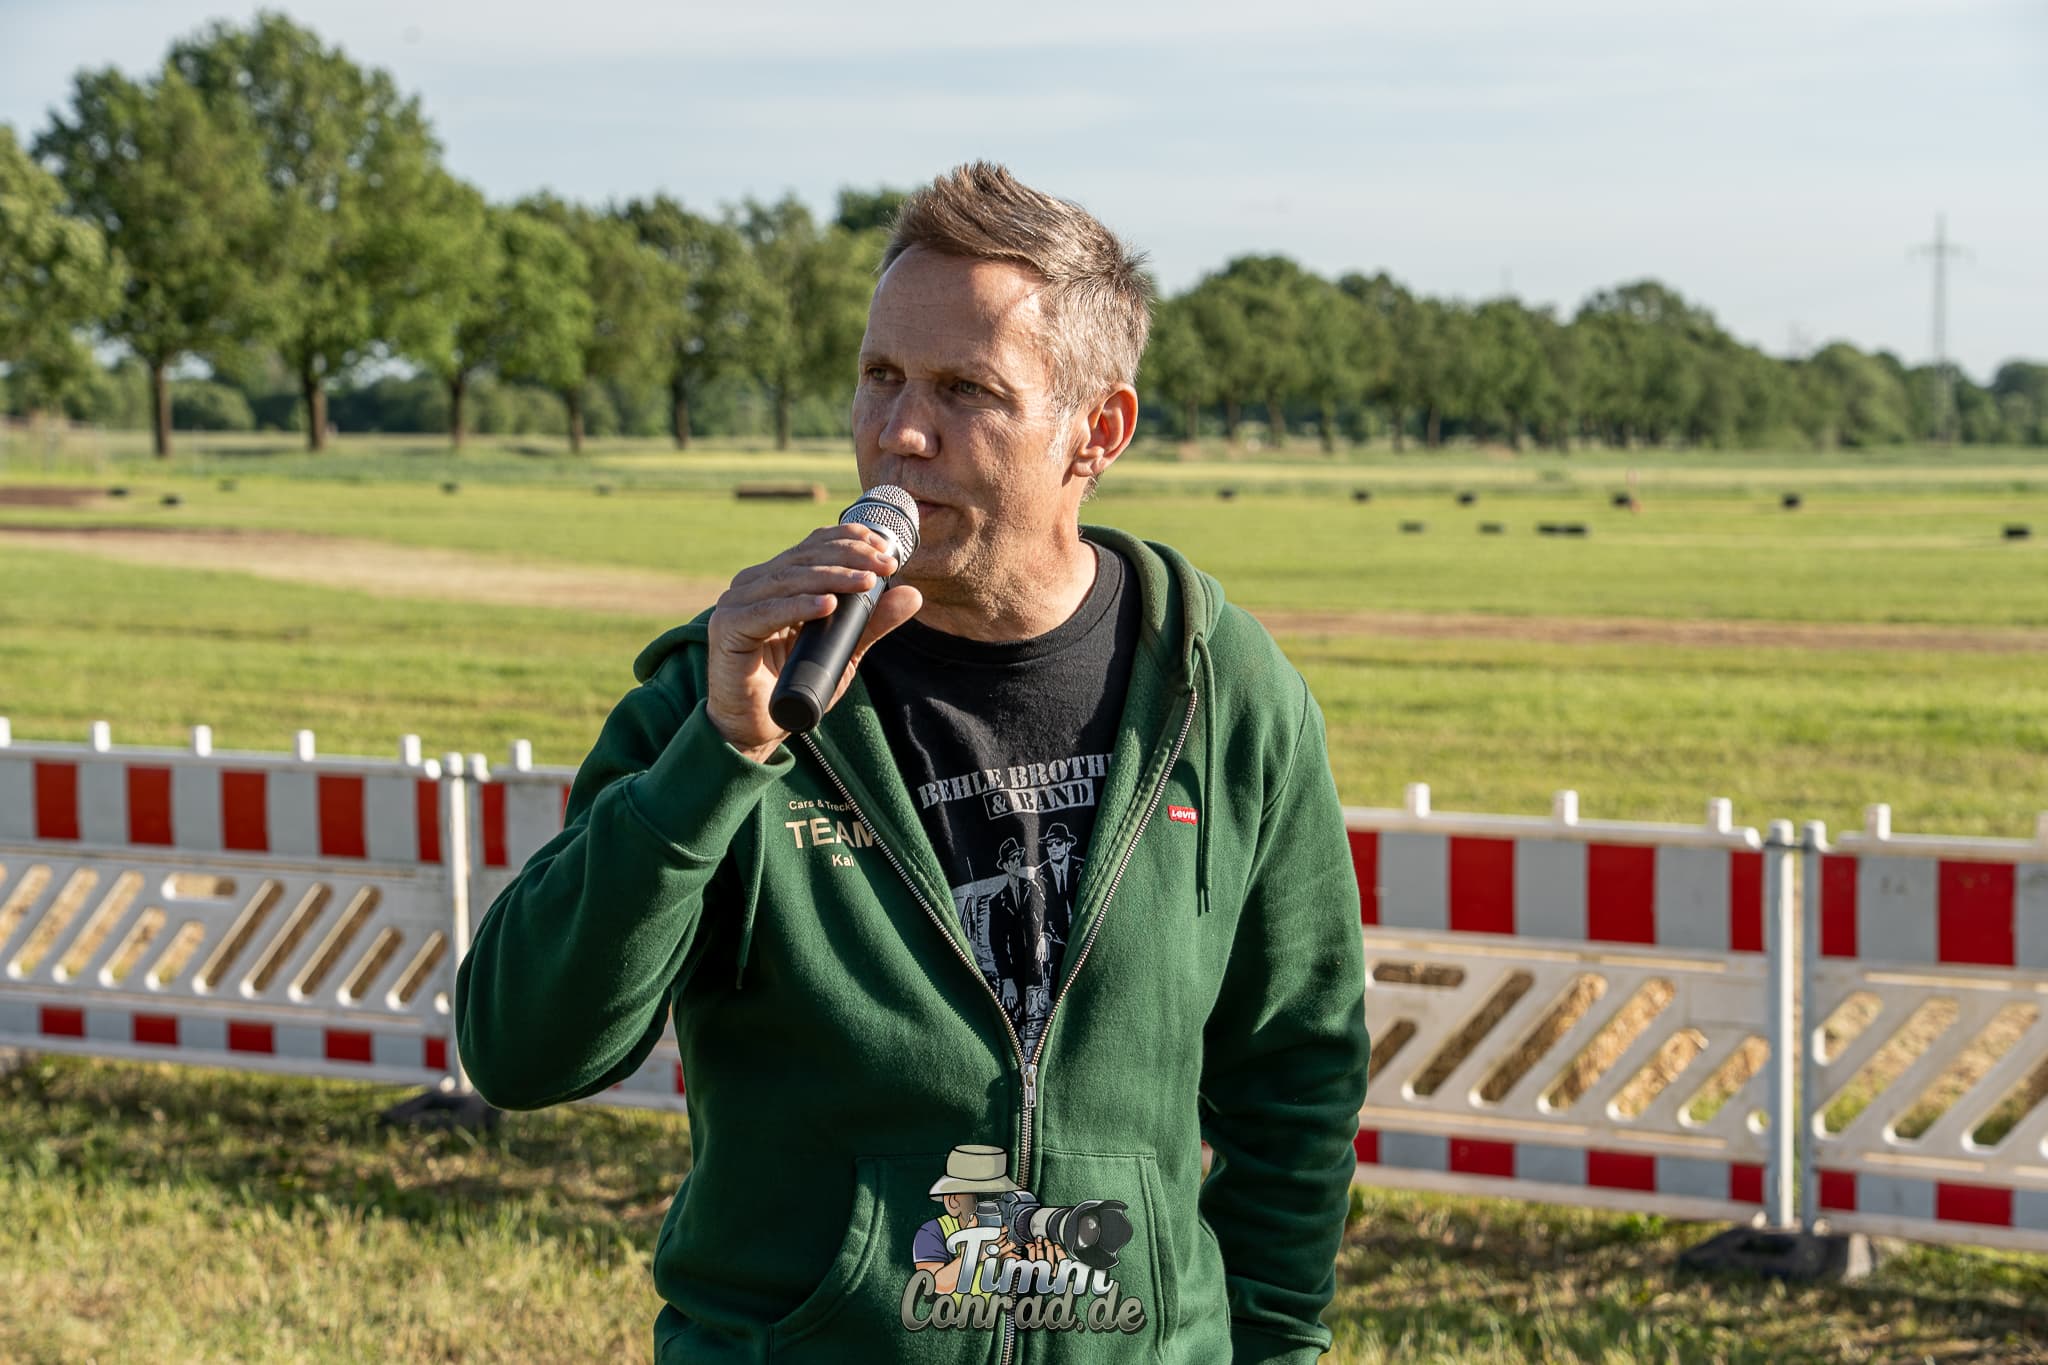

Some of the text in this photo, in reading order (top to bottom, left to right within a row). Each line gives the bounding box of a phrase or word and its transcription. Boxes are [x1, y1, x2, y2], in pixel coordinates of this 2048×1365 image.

[788, 800, 815, 810] Cars
[817, 799, 825, 808] &
[917, 768, 1004, 809] BEHLE
[992, 782, 1089, 815] & BAND
[784, 817, 874, 849] TEAM
[832, 853, 855, 867] Kai
